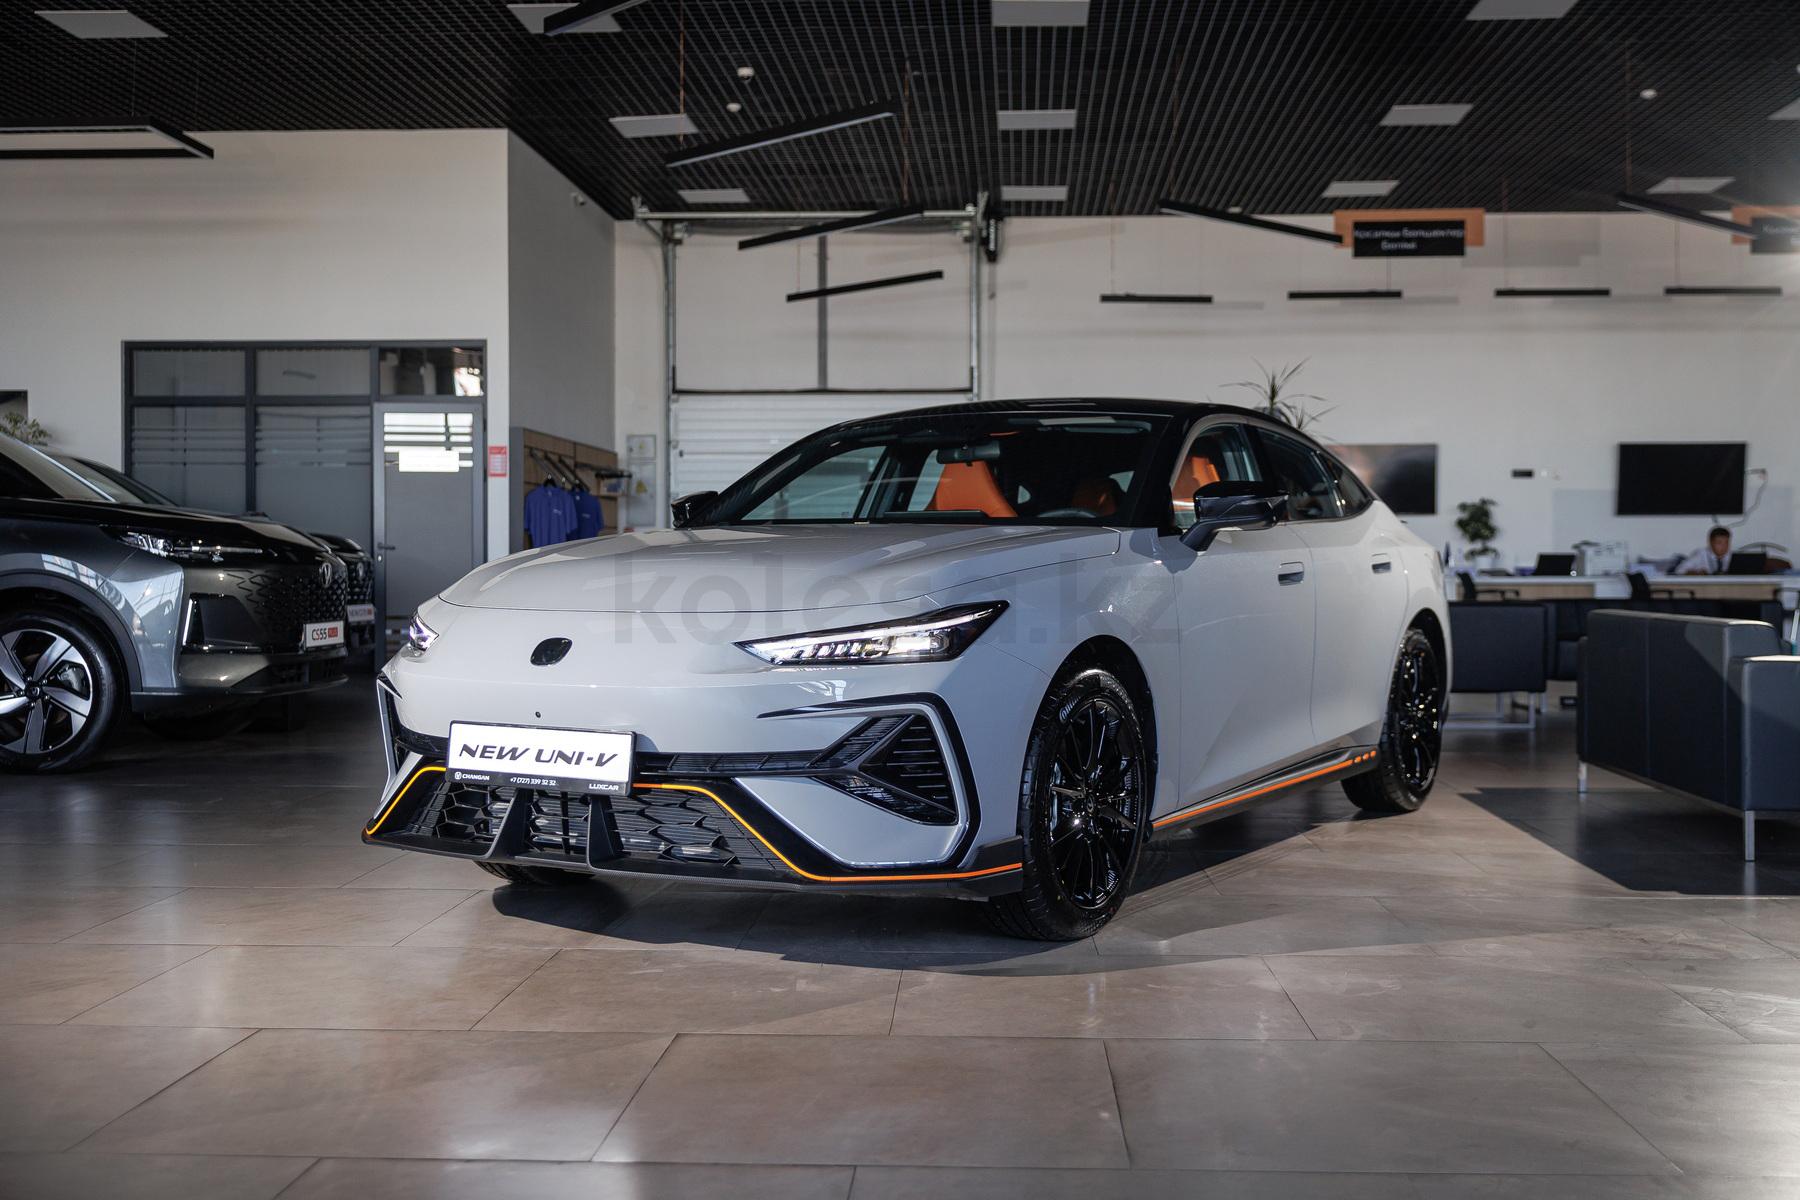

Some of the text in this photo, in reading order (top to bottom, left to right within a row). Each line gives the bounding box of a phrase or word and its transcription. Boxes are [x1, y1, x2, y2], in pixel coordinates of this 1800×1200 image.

[311, 628, 327, 641] CS55
[459, 743, 618, 767] NEW UNI-V
[462, 773, 490, 781] CHANGAN
[517, 777, 530, 785] (727)
[588, 783, 620, 791] LUXCAR
